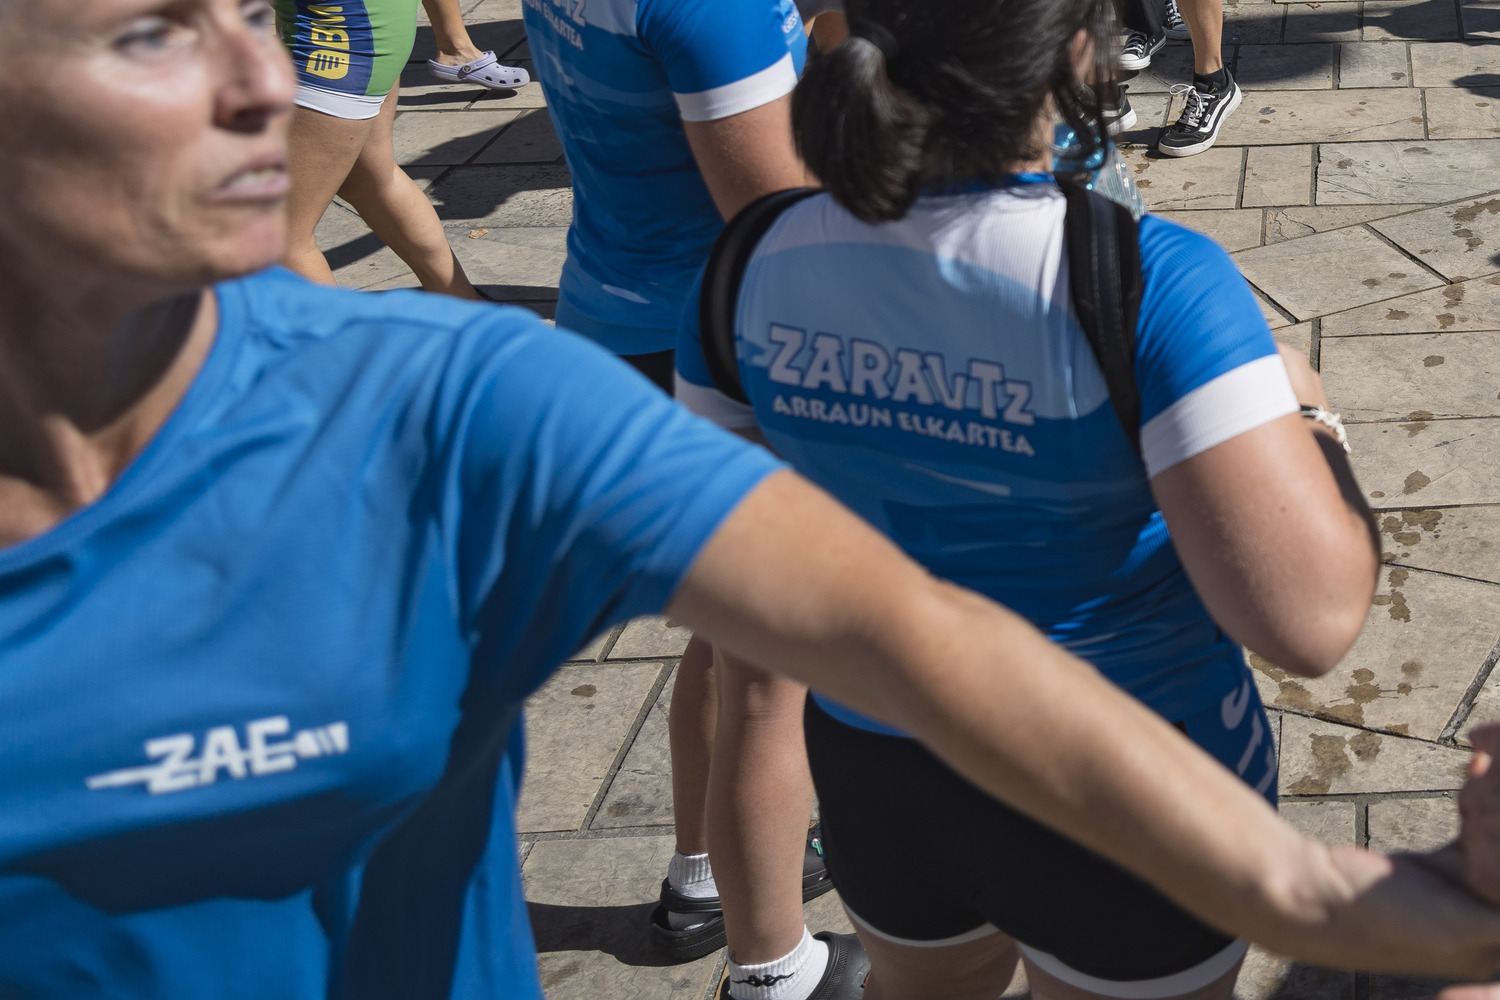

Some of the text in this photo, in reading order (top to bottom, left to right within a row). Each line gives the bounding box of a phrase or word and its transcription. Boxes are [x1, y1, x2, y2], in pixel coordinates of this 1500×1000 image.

[310, 5, 351, 51] BM
[767, 322, 1036, 426] ZARAUTZ
[772, 395, 1036, 457] ARRAUN ELKARTEA
